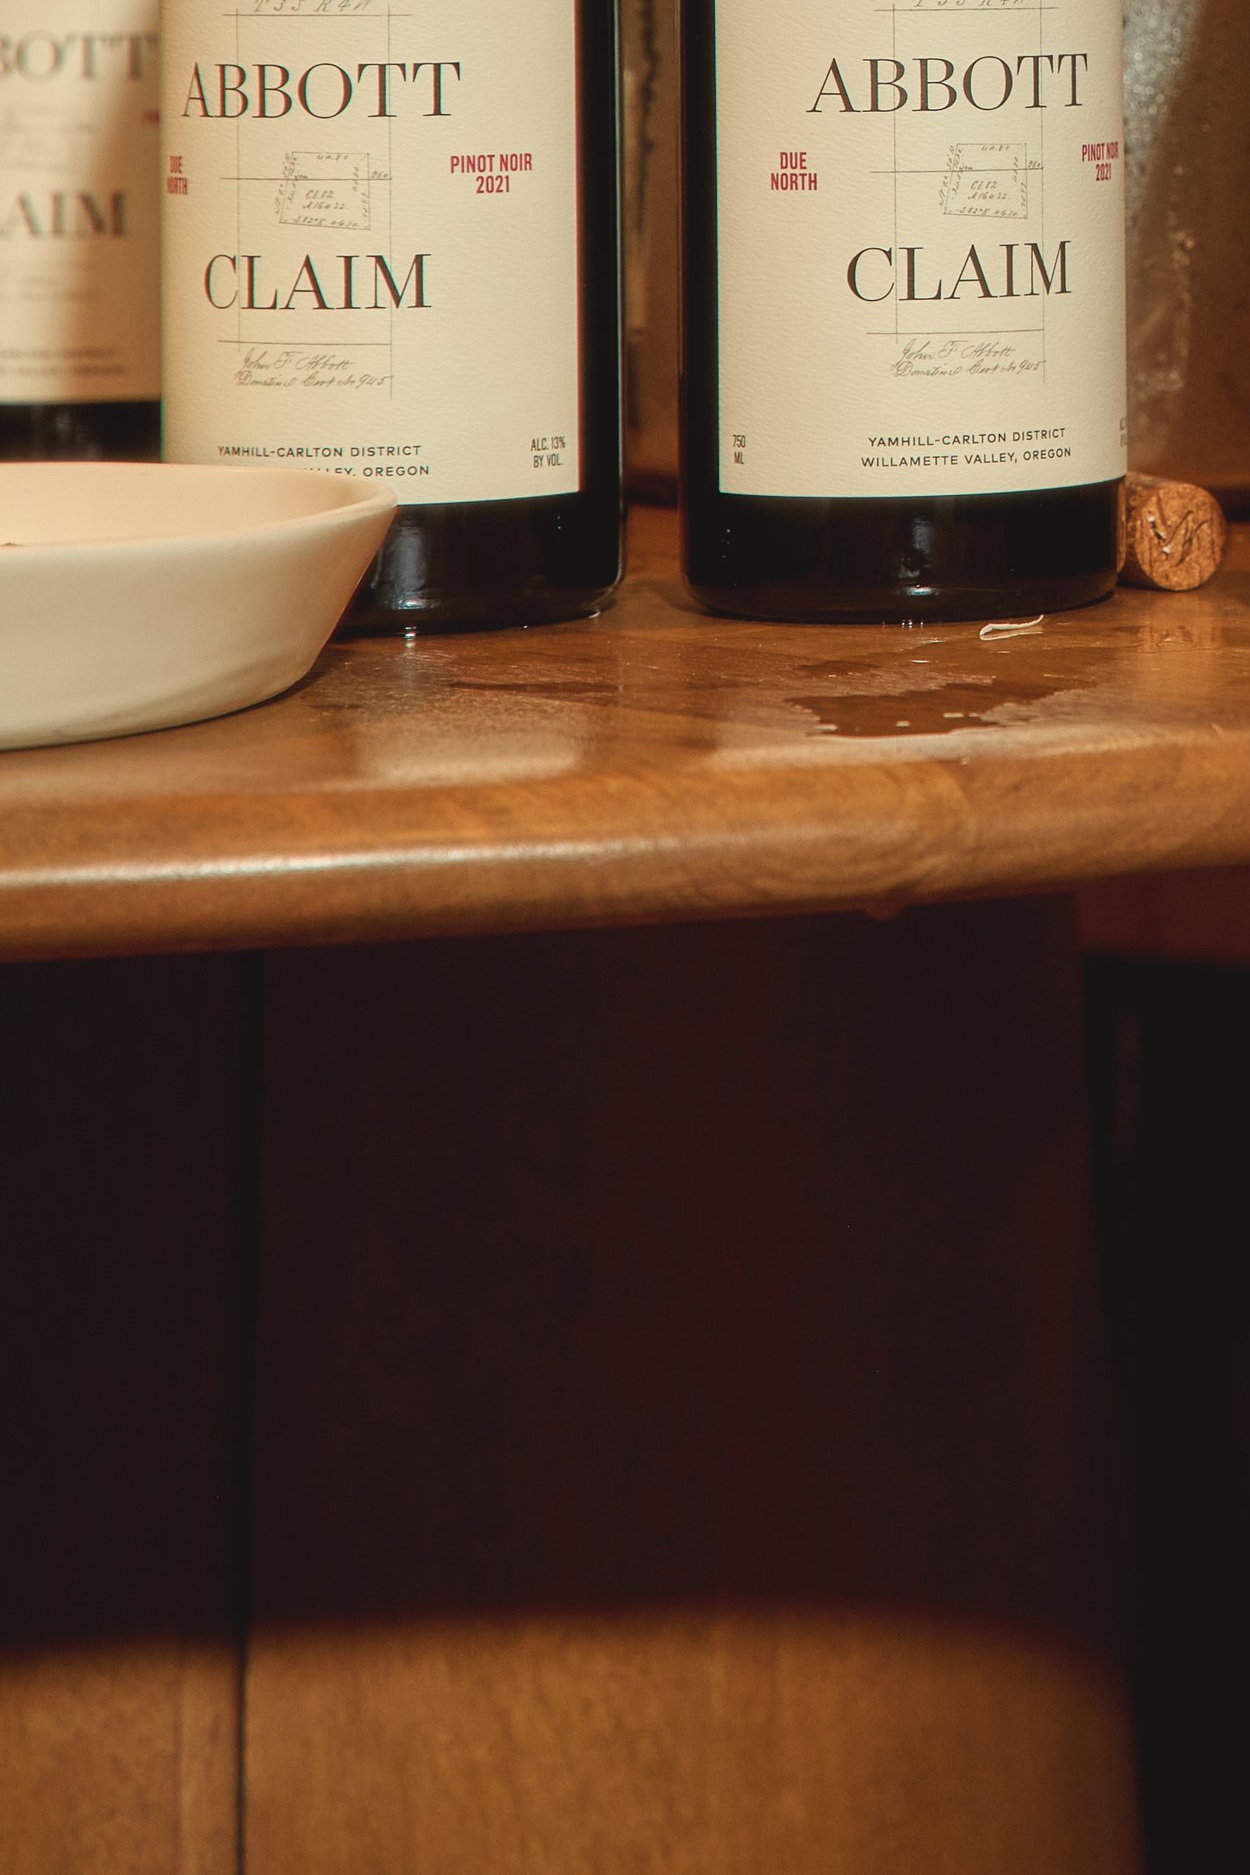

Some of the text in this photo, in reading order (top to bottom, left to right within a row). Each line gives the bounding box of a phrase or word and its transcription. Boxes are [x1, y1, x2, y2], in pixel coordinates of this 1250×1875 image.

[181, 62, 461, 119] ABBOTT
[805, 53, 1087, 113] ABBOTT
[780, 152, 807, 170] DUE
[1081, 142, 1105, 162] PINOT
[450, 153, 533, 174] PINOT NOIR
[1095, 162, 1112, 181] 2021
[476, 175, 510, 194] 2021
[770, 172, 818, 191] NORTH
[847, 240, 1072, 302] CLAIM
[204, 253, 432, 310] CLAIM
[531, 436, 566, 452] ALC. 13%
[732, 435, 746, 449] 750
[868, 428, 1066, 448] YAMHILL-CARLTON DISTRICT
[217, 445, 421, 458] YAMHILL-CARLTON DISTRICT
[533, 453, 563, 468] BY VOL.
[734, 451, 745, 465] ML
[861, 447, 1072, 468] WILLAMETTE VALLEY, OREGON
[363, 465, 429, 477] OREGON
